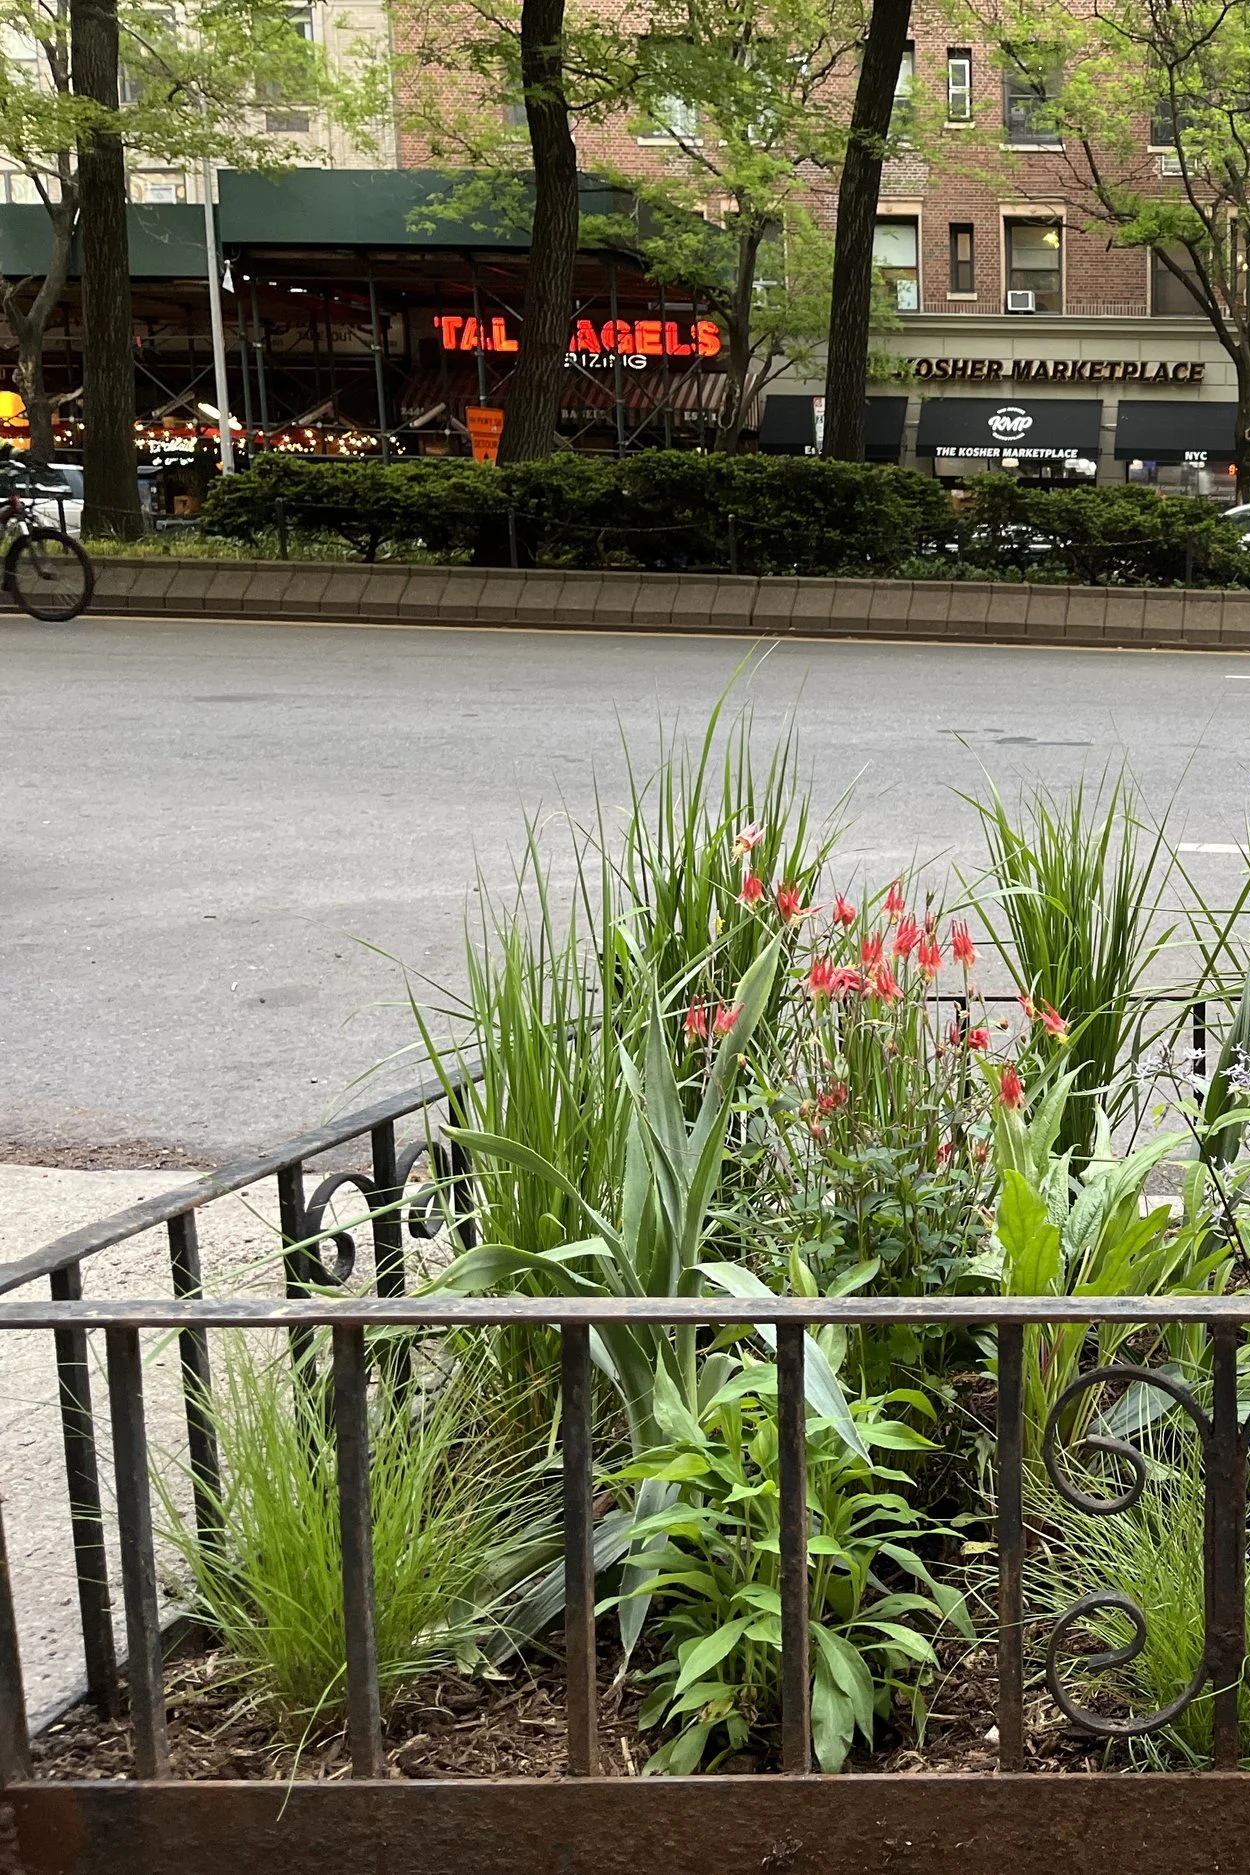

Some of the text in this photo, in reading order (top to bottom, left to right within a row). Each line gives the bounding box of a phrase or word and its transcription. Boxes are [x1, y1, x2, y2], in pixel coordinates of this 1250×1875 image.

[434, 316, 721, 357] TAL AGELS
[1011, 360, 1206, 383] MARKETPLACE
[987, 415, 1034, 432] KMP
[936, 447, 1078, 459] THE KOSHER MARKETPLACE
[1184, 451, 1208, 461] NYC
